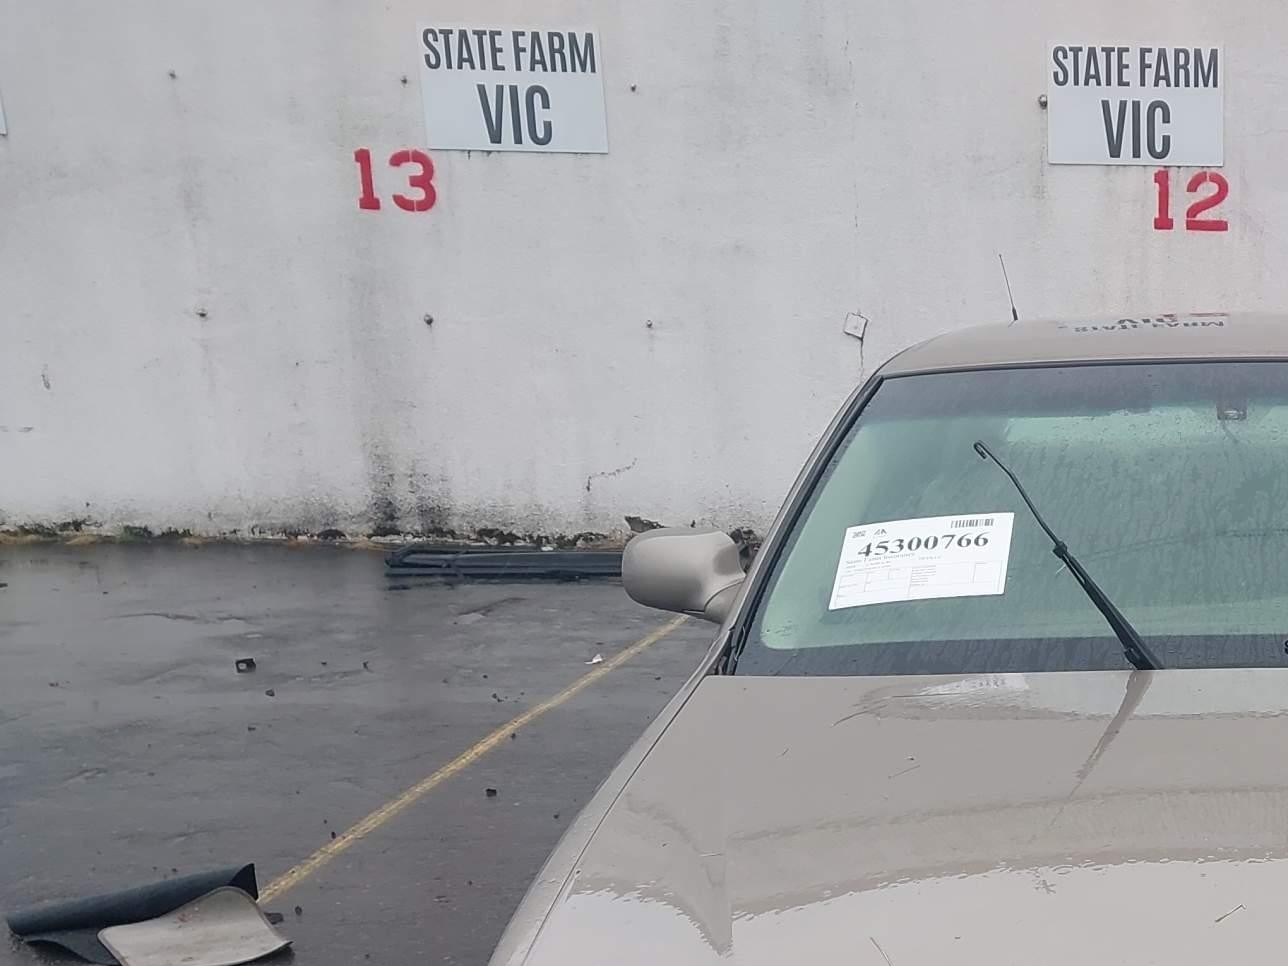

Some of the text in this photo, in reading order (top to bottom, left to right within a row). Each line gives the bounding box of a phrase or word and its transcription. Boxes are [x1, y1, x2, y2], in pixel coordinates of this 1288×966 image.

[423, 29, 596, 73] STATE FARM
[1053, 46, 1218, 88] STATE FARM
[477, 84, 552, 145] VIC
[1101, 100, 1170, 159] VIC
[356, 149, 437, 212] 13
[1153, 170, 1229, 232] 12
[857, 532, 989, 557] 45300766
